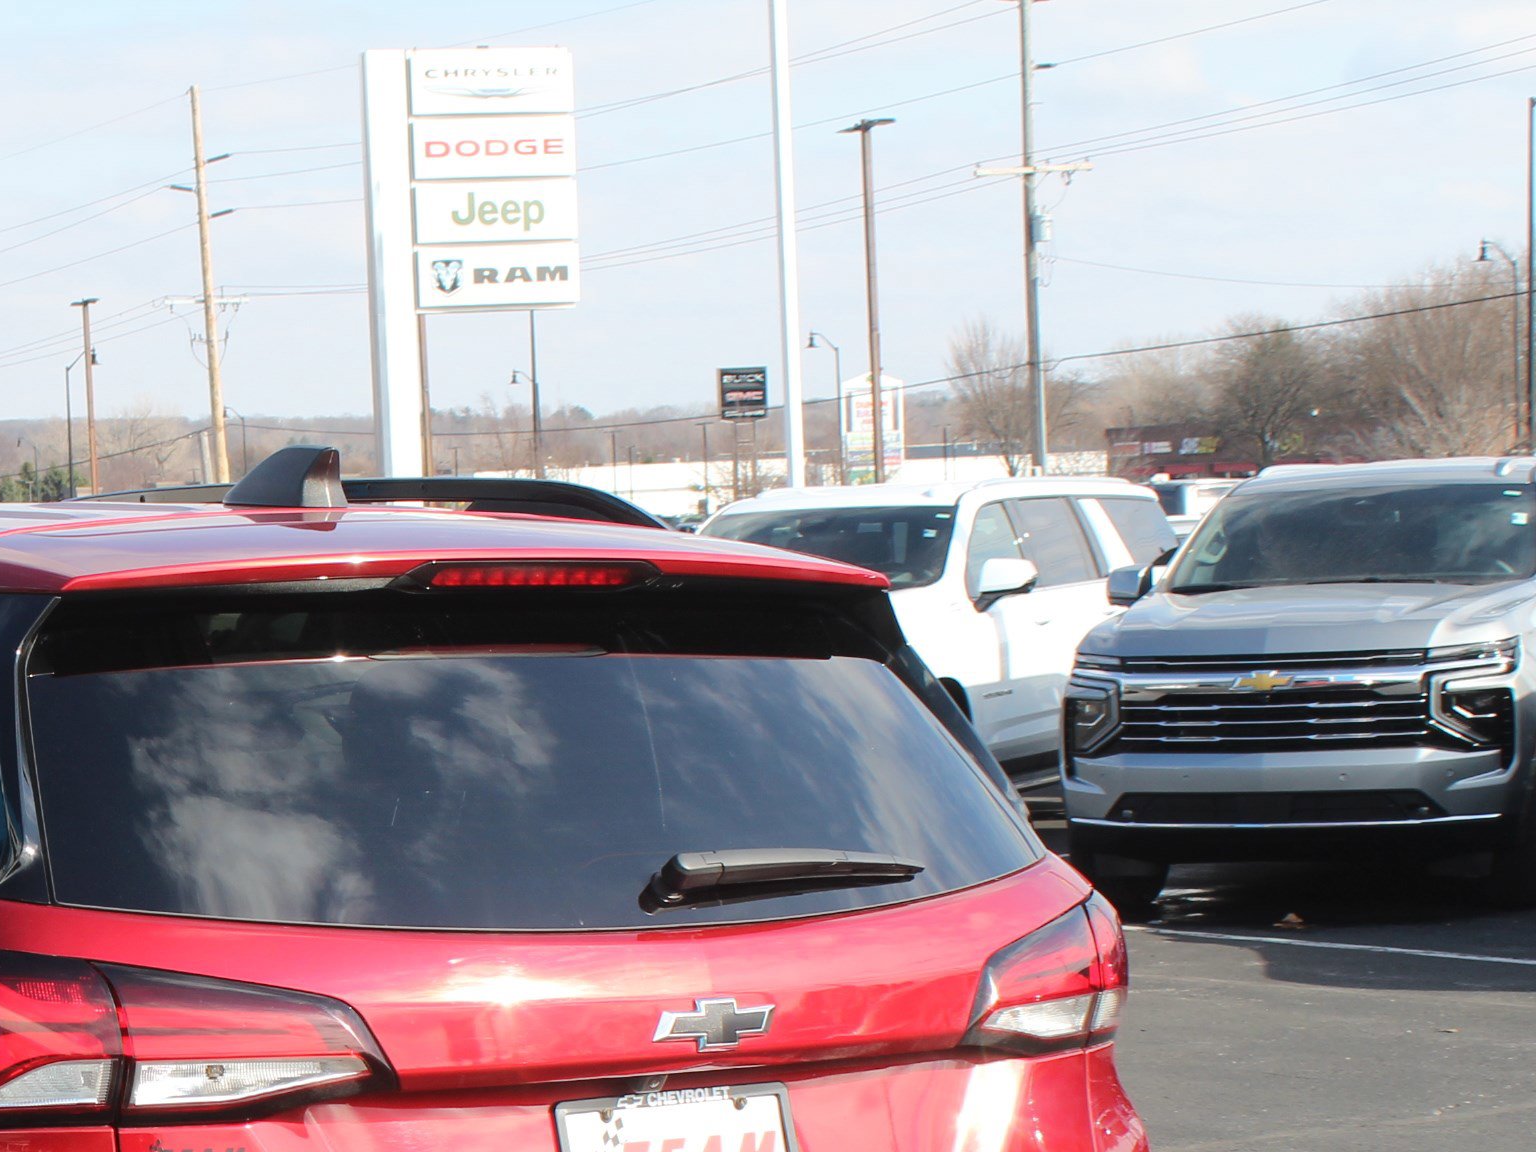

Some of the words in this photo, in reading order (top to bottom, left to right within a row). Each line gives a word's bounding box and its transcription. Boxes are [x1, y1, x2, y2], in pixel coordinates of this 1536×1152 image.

[424, 67, 559, 78] CHRYSLER
[424, 138, 564, 158] DODGE
[451, 191, 545, 231] Jeep
[473, 265, 569, 284] RAM
[723, 373, 764, 383] BUICK
[646, 1085, 730, 1108] CHEVROLET
